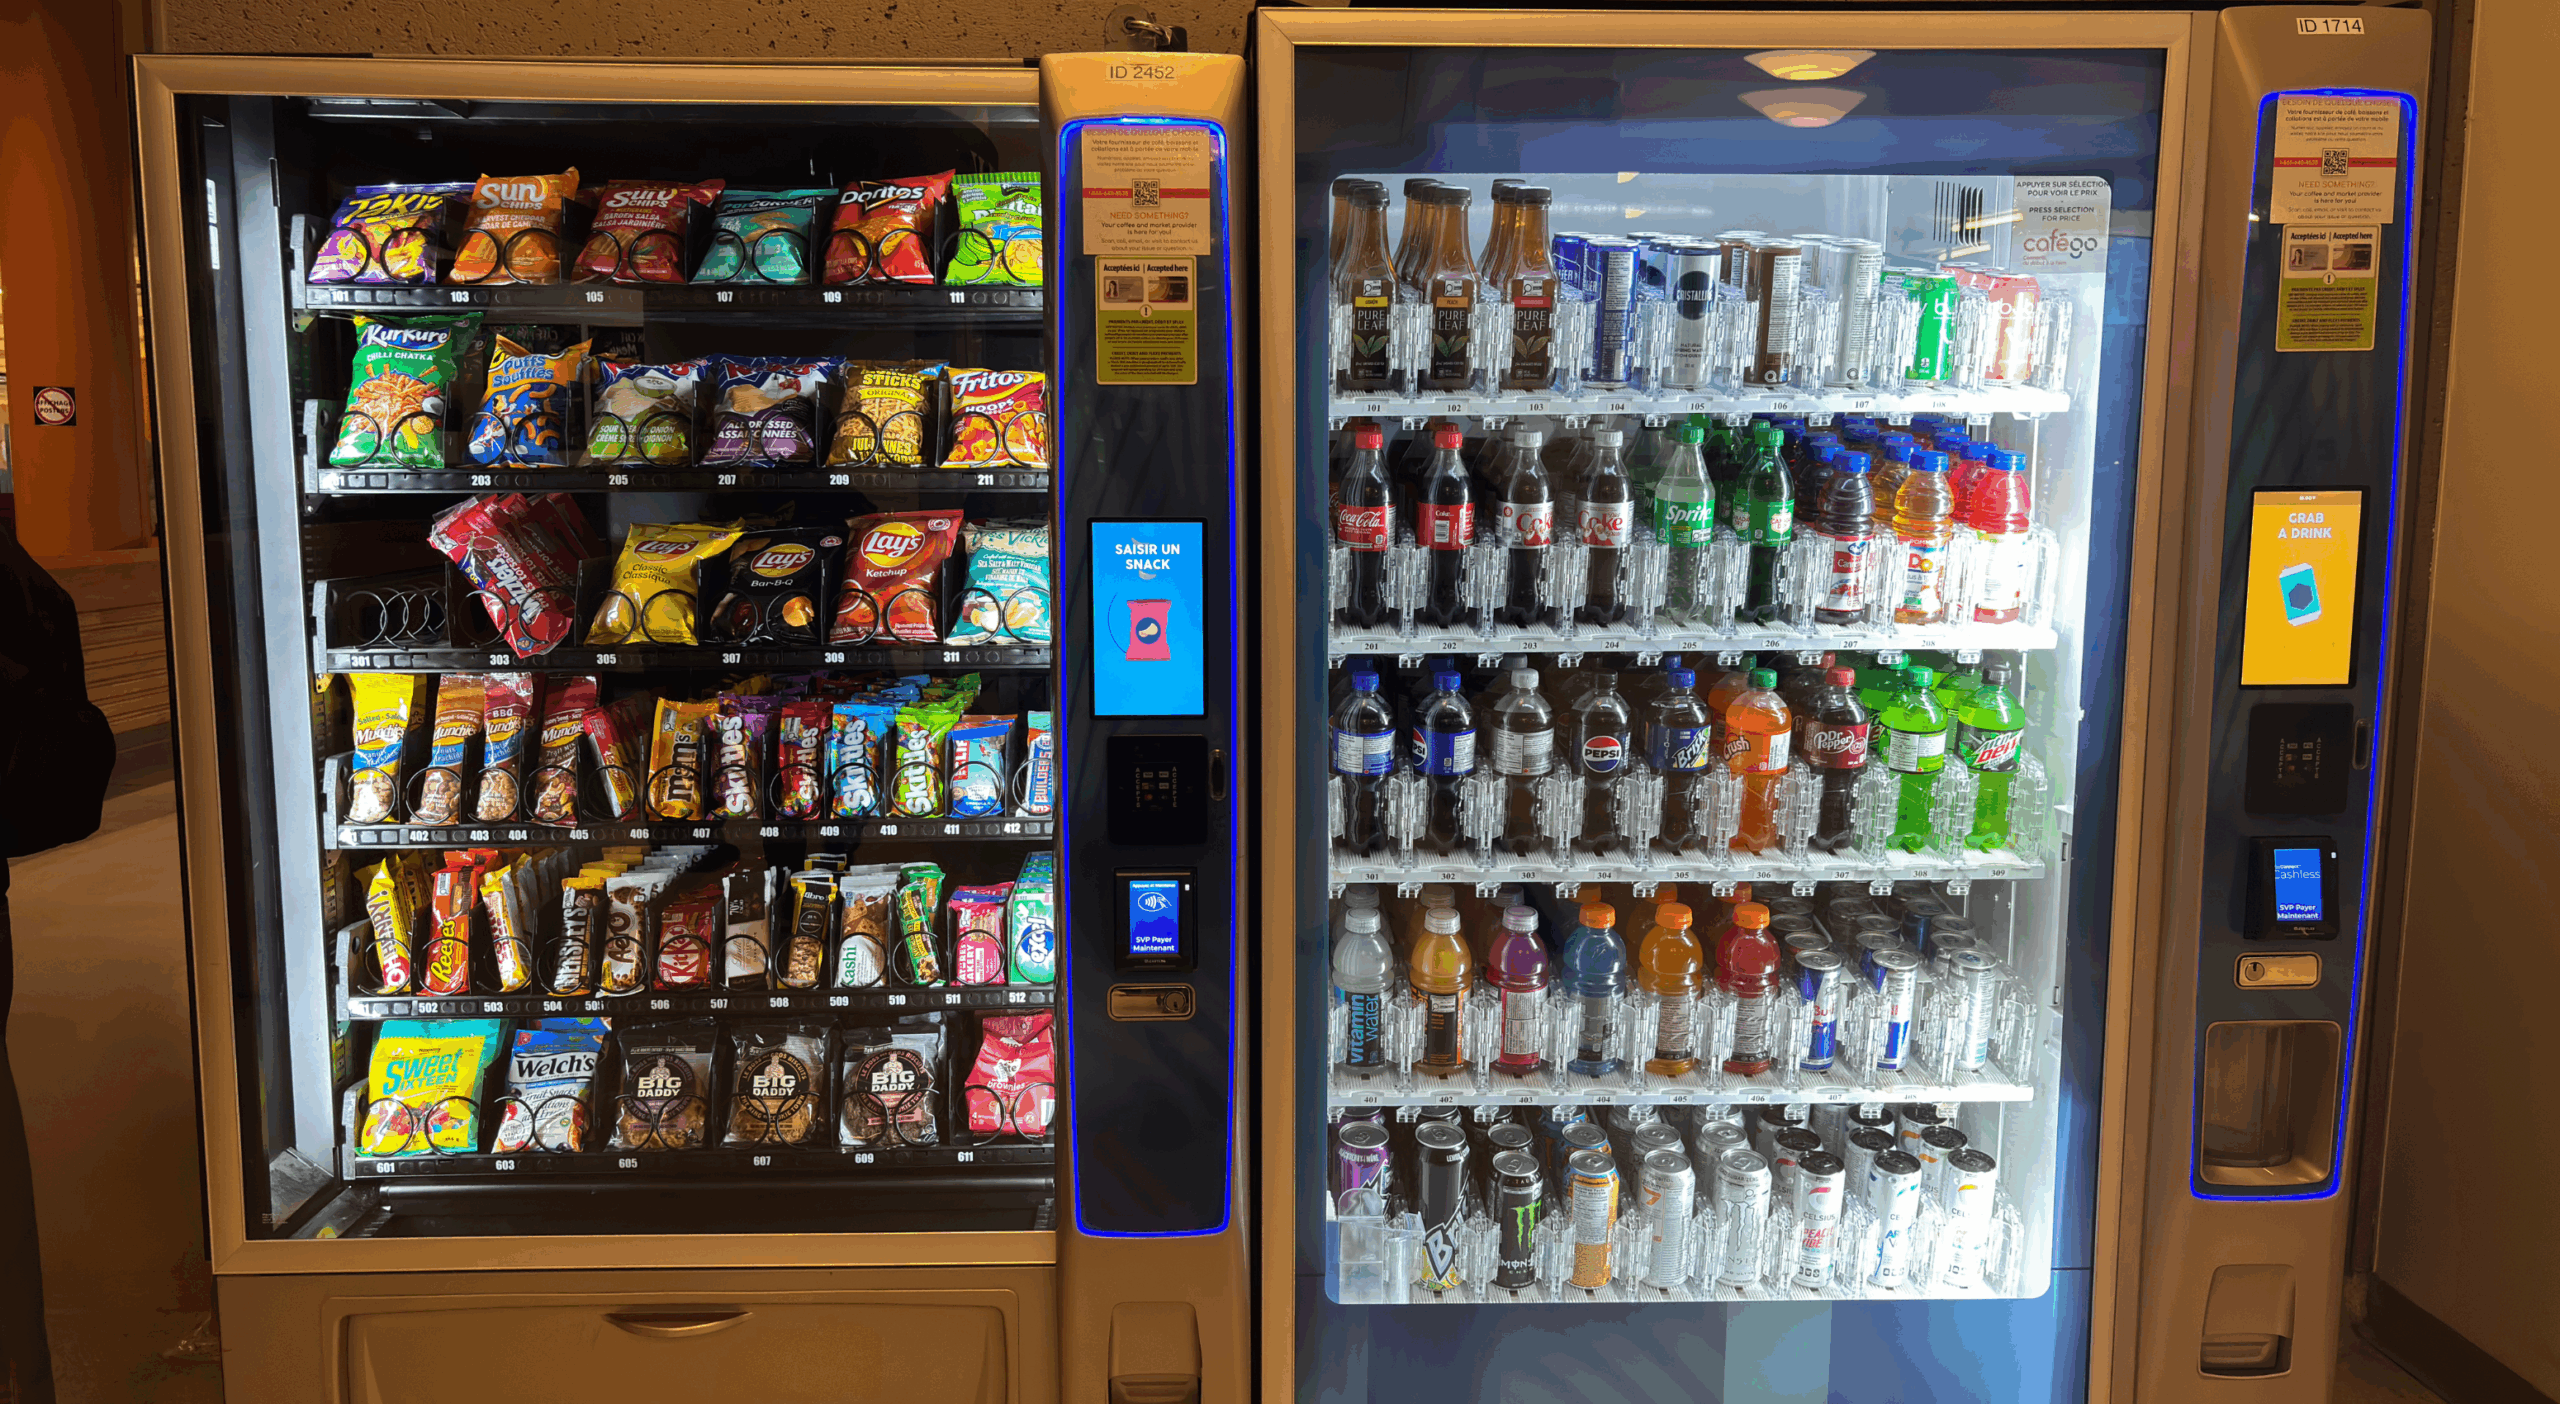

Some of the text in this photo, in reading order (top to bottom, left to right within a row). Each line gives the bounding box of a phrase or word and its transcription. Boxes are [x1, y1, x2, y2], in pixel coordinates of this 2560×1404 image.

[2299, 19, 2361, 32] ID 1714
[1110, 66, 1174, 78] ID 2452
[2069, 180, 2109, 188] SÉLECTION
[478, 183, 547, 209] Sun
[840, 187, 925, 204] Doritos
[501, 201, 543, 210] CHIPS
[593, 220, 667, 229] SALSA JARDINIÈRE
[2333, 233, 2358, 241] Accepted
[2024, 229, 2097, 259] cafégo
[1104, 264, 1132, 272] Acceptées
[451, 292, 469, 302] 103
[716, 292, 733, 302] 107
[950, 292, 964, 302] 111
[1358, 310, 1385, 320] PURE
[1439, 310, 1465, 320] PURE
[1517, 310, 1546, 320] PURE
[1358, 321, 1385, 331] LEAF
[1438, 321, 1465, 331] LEAF
[1517, 321, 1546, 331] LEAF
[366, 325, 450, 348] Kurkure
[367, 352, 433, 362] CHILLI CHATKA
[503, 356, 546, 371] Puffs
[863, 374, 924, 390] STICKS
[952, 371, 1025, 398] Fritos
[965, 398, 1014, 413] HOOPS
[1367, 404, 1381, 412] 101
[1529, 403, 1544, 411] 103
[1690, 403, 1705, 411] 105
[727, 421, 744, 429] ALL
[471, 475, 491, 486] 203
[718, 475, 736, 485] 207
[978, 475, 993, 485] 211
[1666, 505, 1712, 522] Sprite
[2289, 513, 2324, 523] GRAB
[1579, 509, 1622, 532] Coke
[2278, 528, 2332, 538] A DRINK
[638, 540, 696, 555] Lay's
[865, 532, 922, 558] Lay's
[1115, 544, 1180, 555] SAISIR UN
[755, 550, 811, 569] Lay's
[1126, 559, 1170, 569] SNACK
[632, 563, 668, 575] Classic
[866, 568, 907, 578] Ketchup
[751, 579, 794, 588] Bar-B-Q
[1442, 642, 1457, 650] 202
[1765, 640, 1780, 648] 206
[490, 655, 510, 666] 303
[722, 653, 741, 663] 307
[944, 652, 959, 662] 311
[493, 709, 513, 718] BBQ
[1829, 730, 1845, 741] Dr
[1814, 731, 1853, 752] Pepper
[1584, 748, 1620, 759] PEPSI
[902, 729, 936, 815] Skittles
[630, 829, 649, 839] 406
[880, 825, 897, 835] 410
[410, 830, 429, 841] 402
[1674, 871, 1689, 879] 305
[1835, 871, 1849, 879] 307
[1991, 869, 2005, 877] 309
[2297, 904, 2316, 912] Payer
[1027, 917, 1048, 963] excel
[1152, 936, 1172, 944] Payer
[842, 947, 857, 985] Kashi
[384, 957, 406, 986] OH
[770, 997, 789, 1007] 508
[1009, 993, 1026, 1002] 512
[544, 1001, 562, 1011] 504
[1365, 994, 1379, 1042] water
[1350, 995, 1365, 1064] vitamin
[516, 1055, 596, 1077] Welch's
[383, 1049, 464, 1095] Sweet
[638, 1077, 682, 1088] BIG
[753, 1075, 796, 1088] BIG
[872, 1071, 915, 1084] BIG
[871, 1083, 914, 1092] DADDY
[987, 1080, 1025, 1091] brownies
[549, 1088, 578, 1096] Snacks
[638, 1089, 680, 1097] DADDY
[753, 1088, 794, 1097] DADDY
[855, 1154, 874, 1164] 609
[496, 1161, 515, 1171] 603
[1803, 1212, 1835, 1221] CELSIUS
